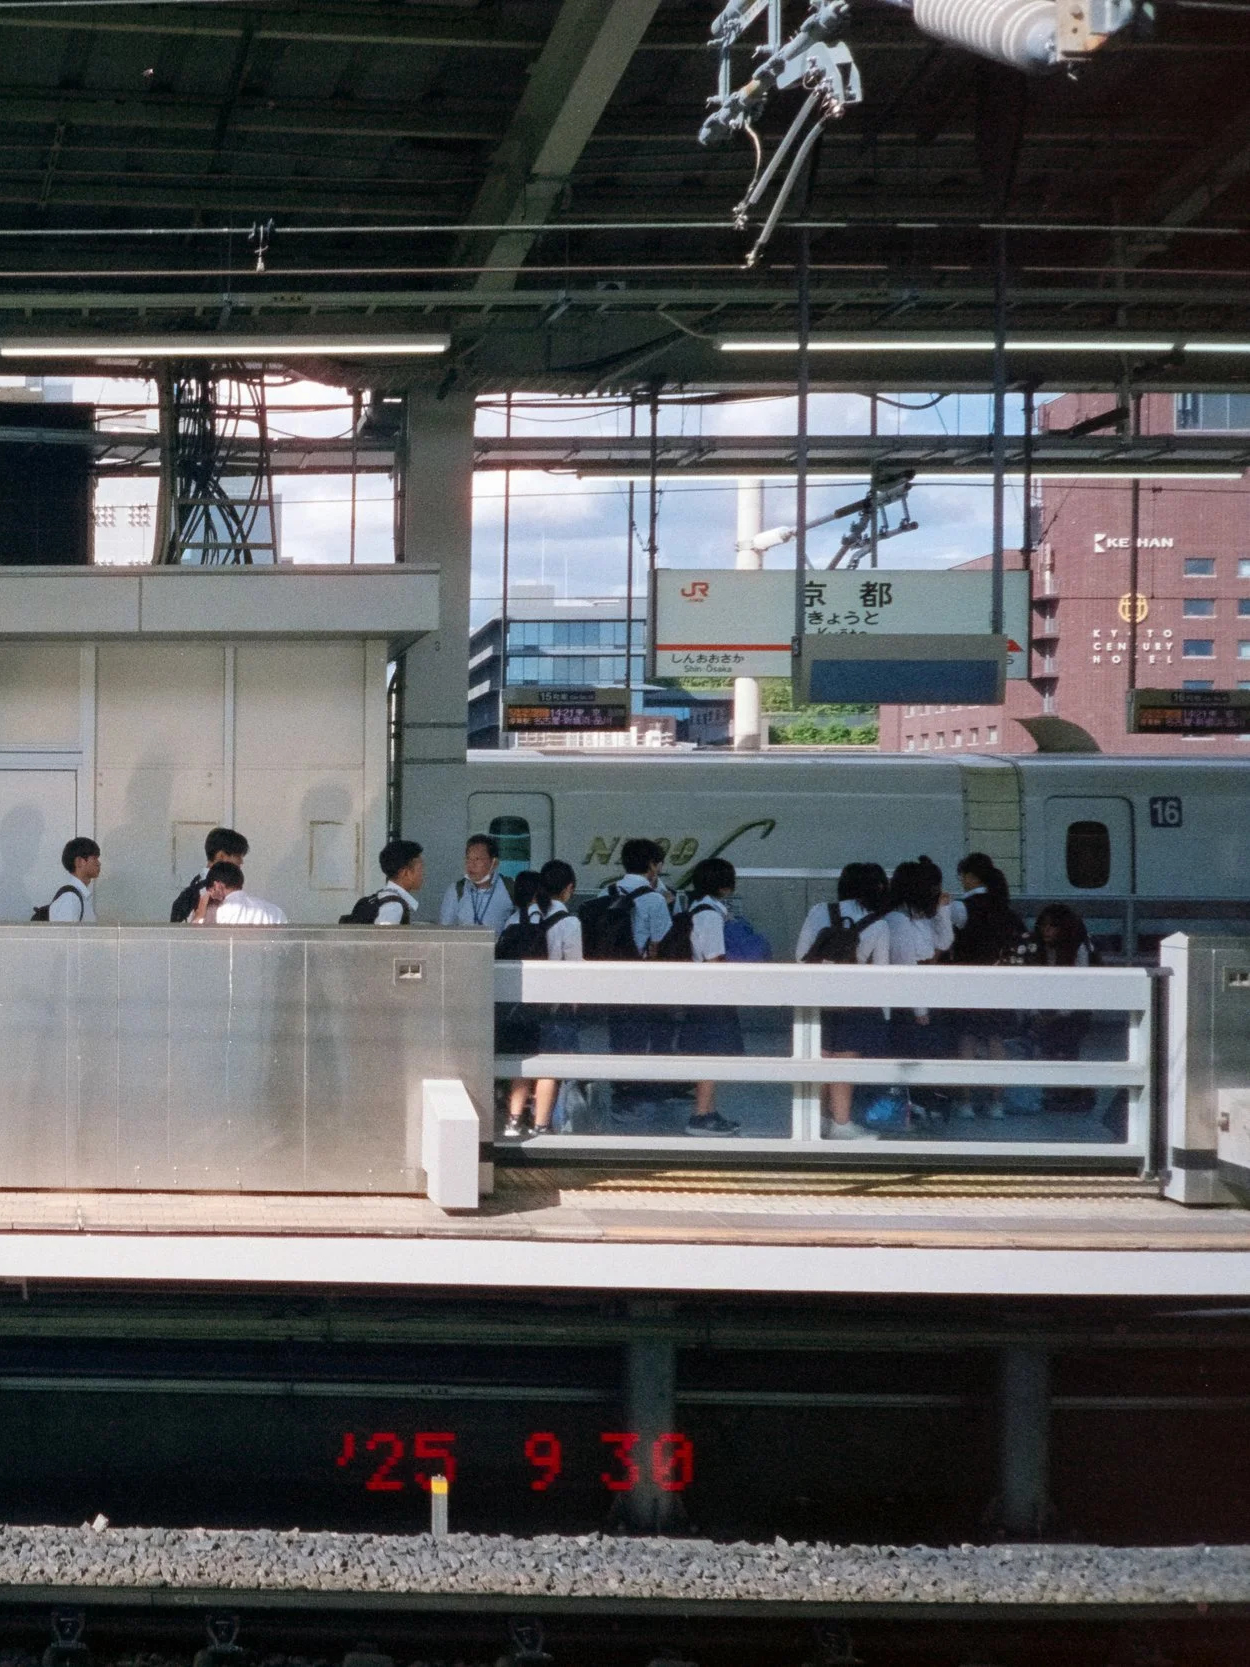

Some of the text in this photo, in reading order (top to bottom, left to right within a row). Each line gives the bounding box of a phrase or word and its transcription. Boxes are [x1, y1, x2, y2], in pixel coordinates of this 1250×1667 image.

[1106, 537, 1174, 548] KEHAN
[681, 582, 709, 597] JR
[804, 580, 892, 608] 京都
[807, 611, 879, 625] きょうと
[1092, 629, 1173, 638] KYTO
[1093, 642, 1173, 651] CENURY
[671, 651, 745, 664] しんおおさか
[1152, 801, 1180, 825] 16
